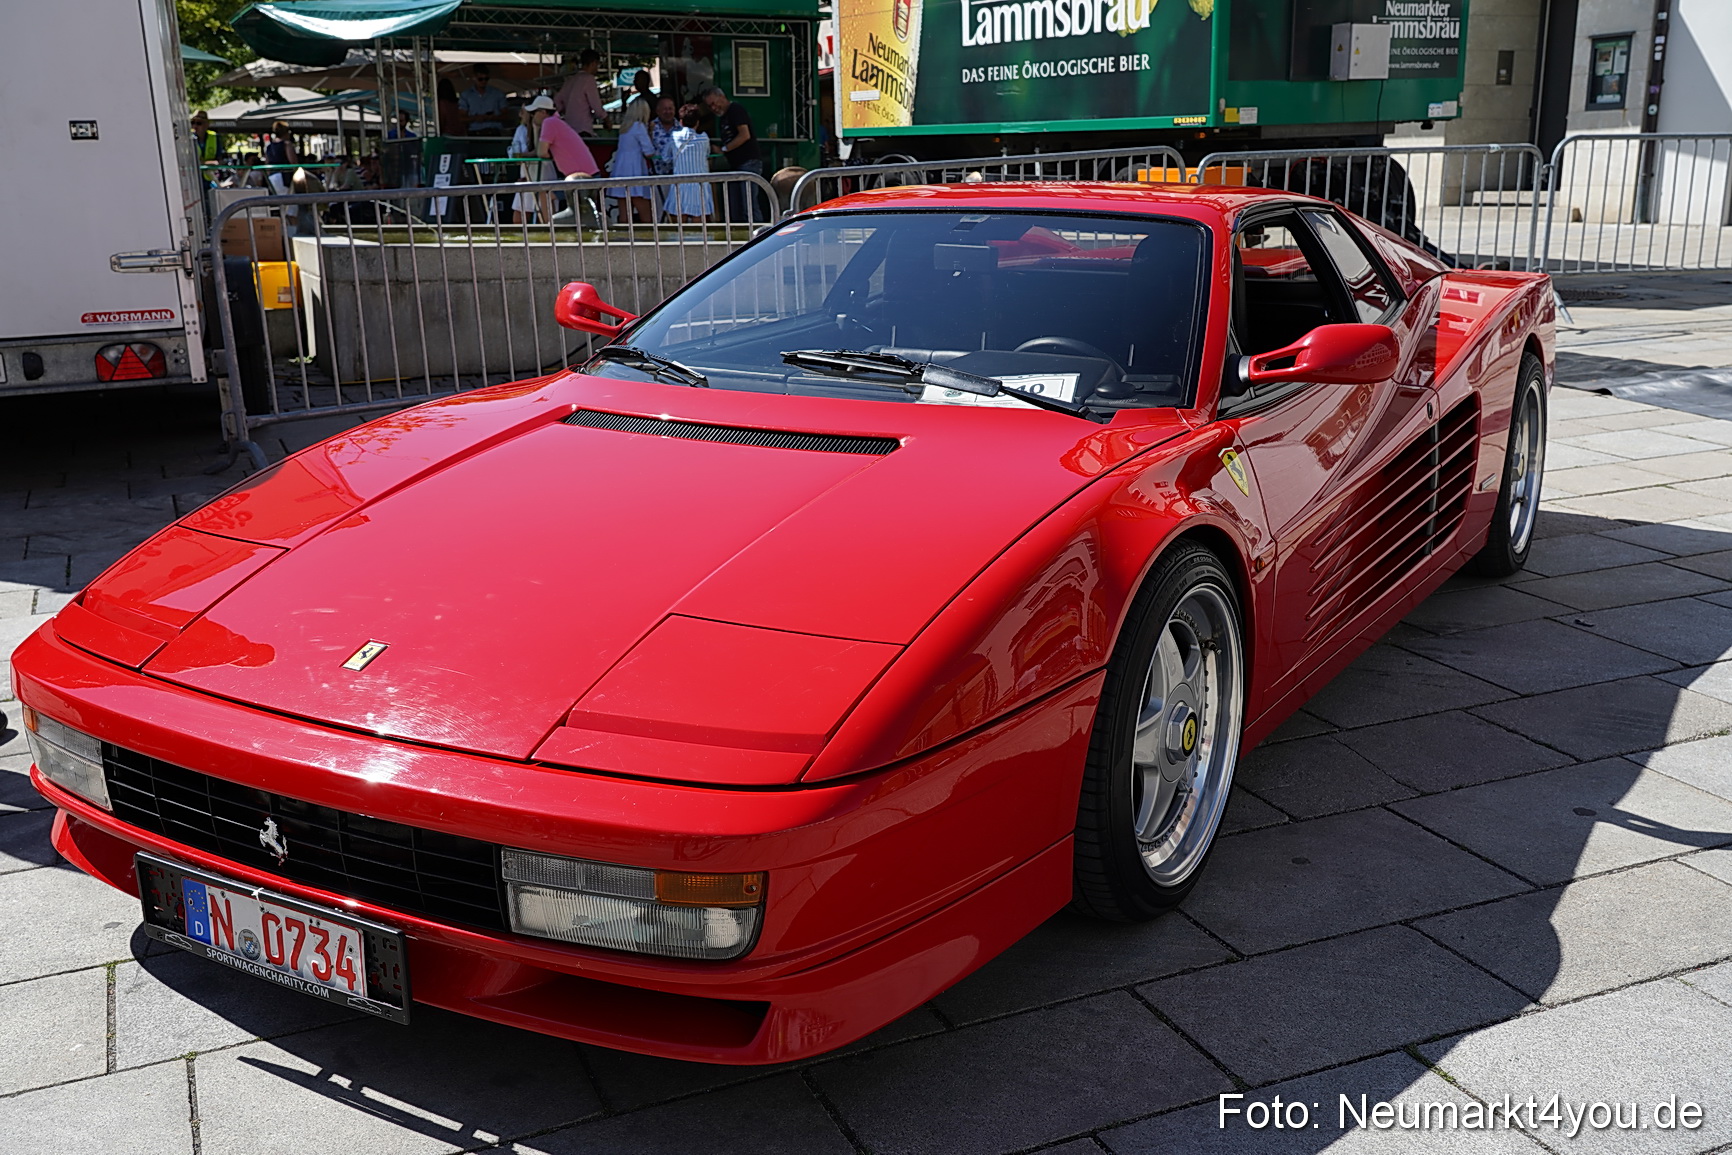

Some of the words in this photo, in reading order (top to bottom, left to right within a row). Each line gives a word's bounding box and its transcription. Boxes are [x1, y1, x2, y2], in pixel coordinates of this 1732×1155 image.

[1385, 0, 1450, 16] Neumarkter
[1372, 15, 1460, 38] mmsbräu
[1445, 47, 1459, 55] BIER
[962, 67, 985, 83] DAS
[988, 64, 1019, 81] FEINE
[1022, 56, 1115, 79] ÖKOLOGISCHE
[1119, 53, 1150, 71] BIER
[96, 311, 171, 322] WÖRMANN
[195, 921, 204, 936] D
[210, 894, 235, 951] N
[261, 912, 357, 991] 0734
[206, 947, 330, 999] SPORTWAGENCHARITY.COM
